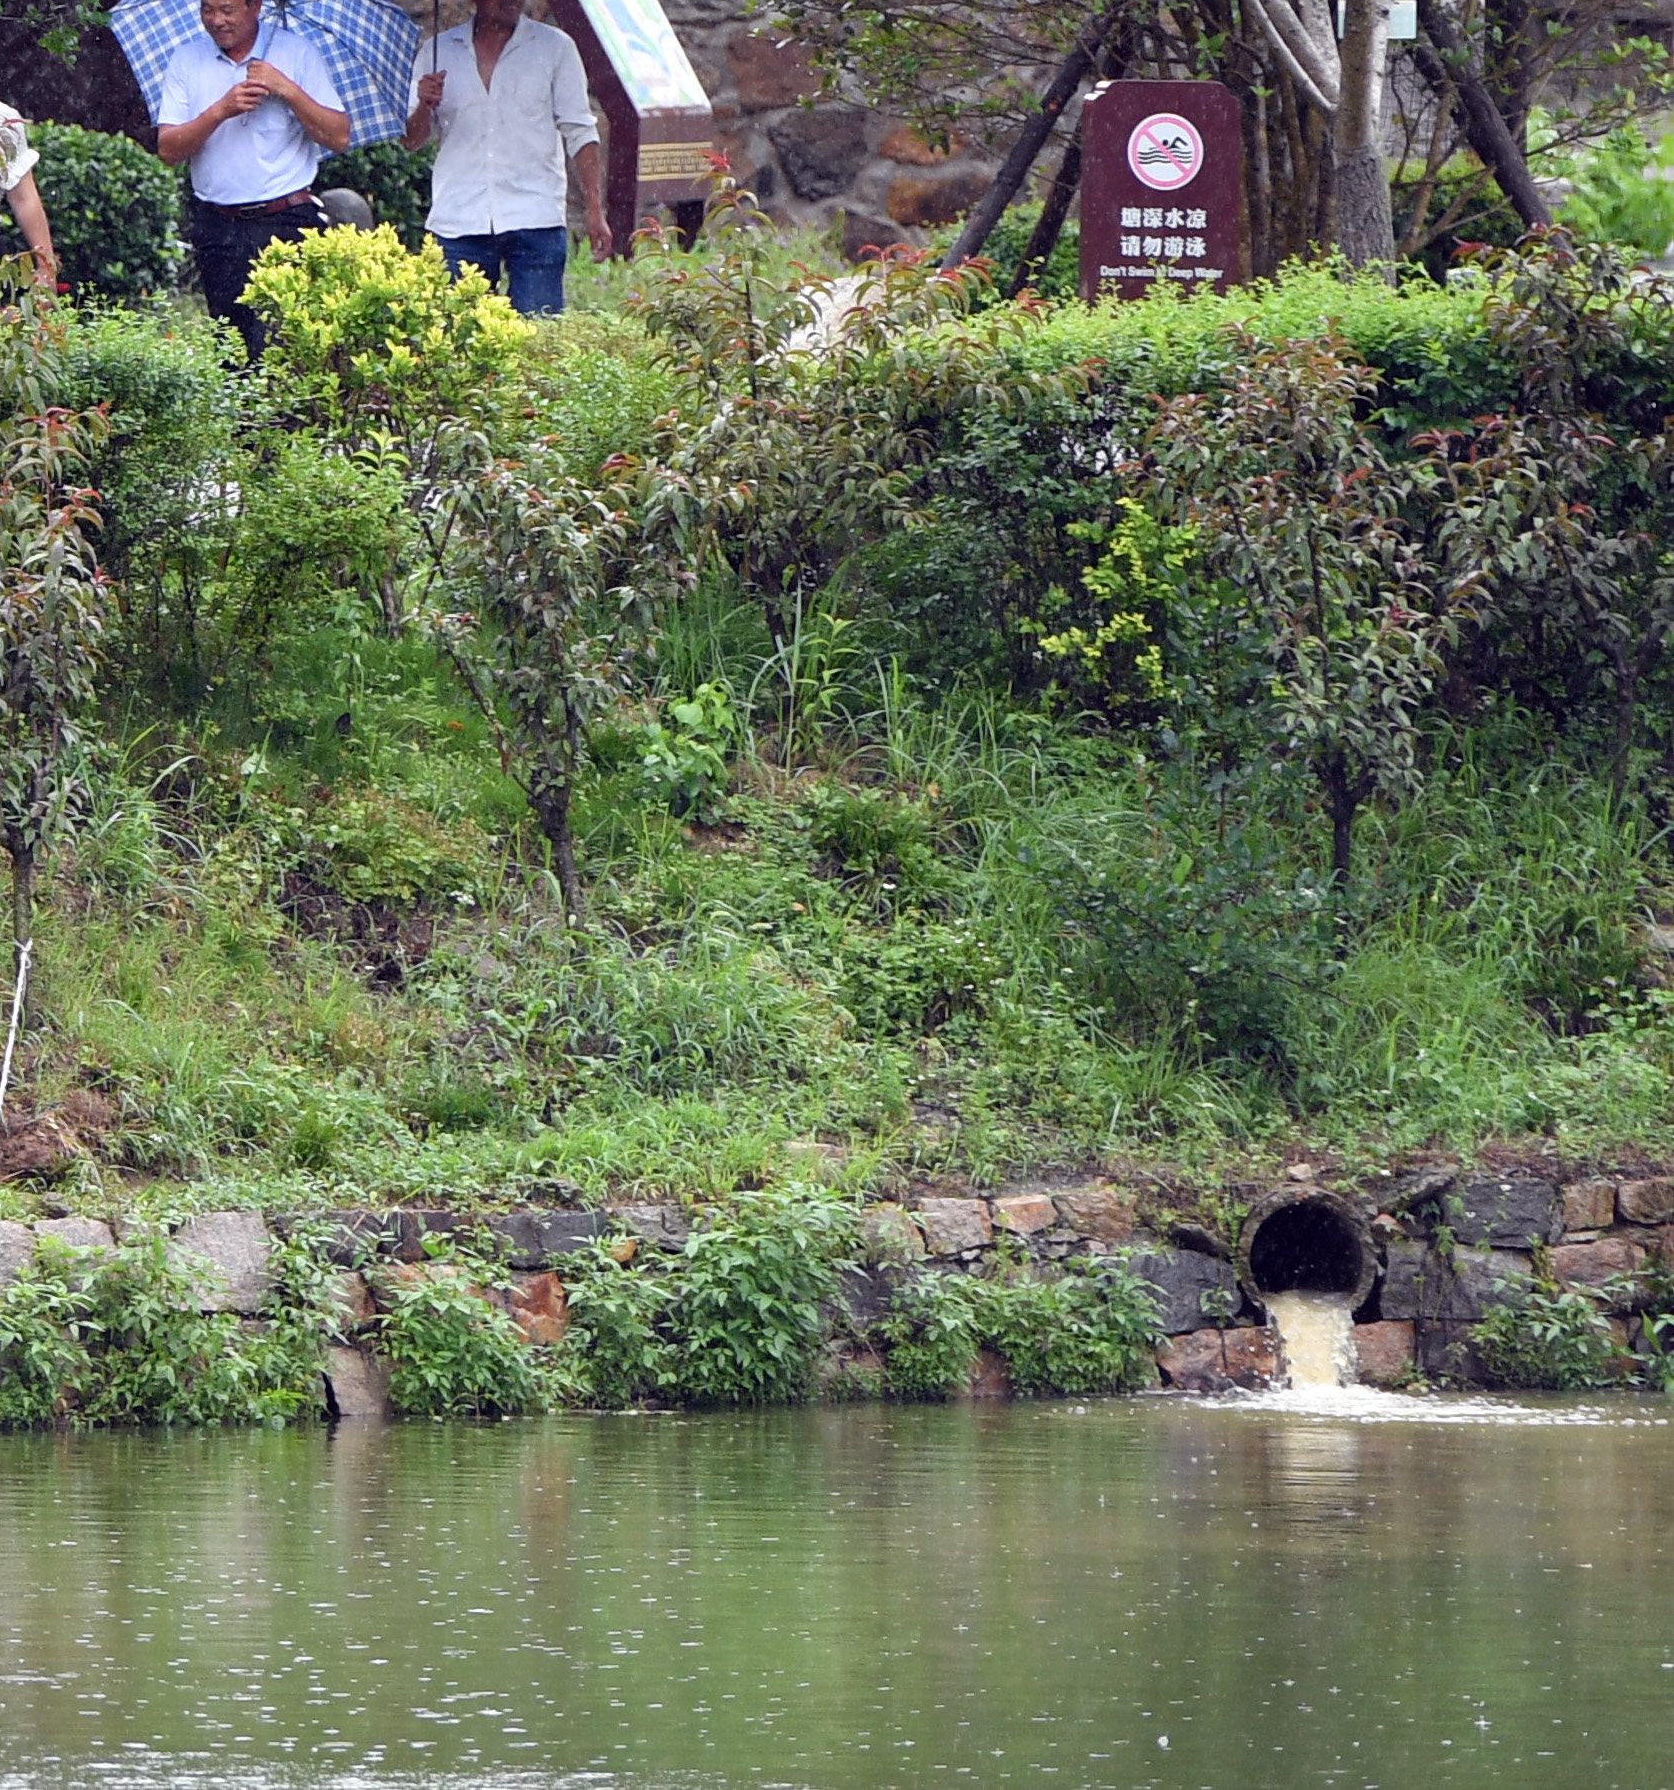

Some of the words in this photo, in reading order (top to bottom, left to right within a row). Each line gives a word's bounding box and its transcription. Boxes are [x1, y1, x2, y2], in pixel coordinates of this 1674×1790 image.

[1120, 207, 1207, 229] 塘深水凉
[1120, 235, 1207, 257] 请勿游泳
[1100, 265, 1127, 277] Don't
[1128, 265, 1155, 277] Swim
[1168, 266, 1193, 280] Deep
[1194, 267, 1224, 279] Water
